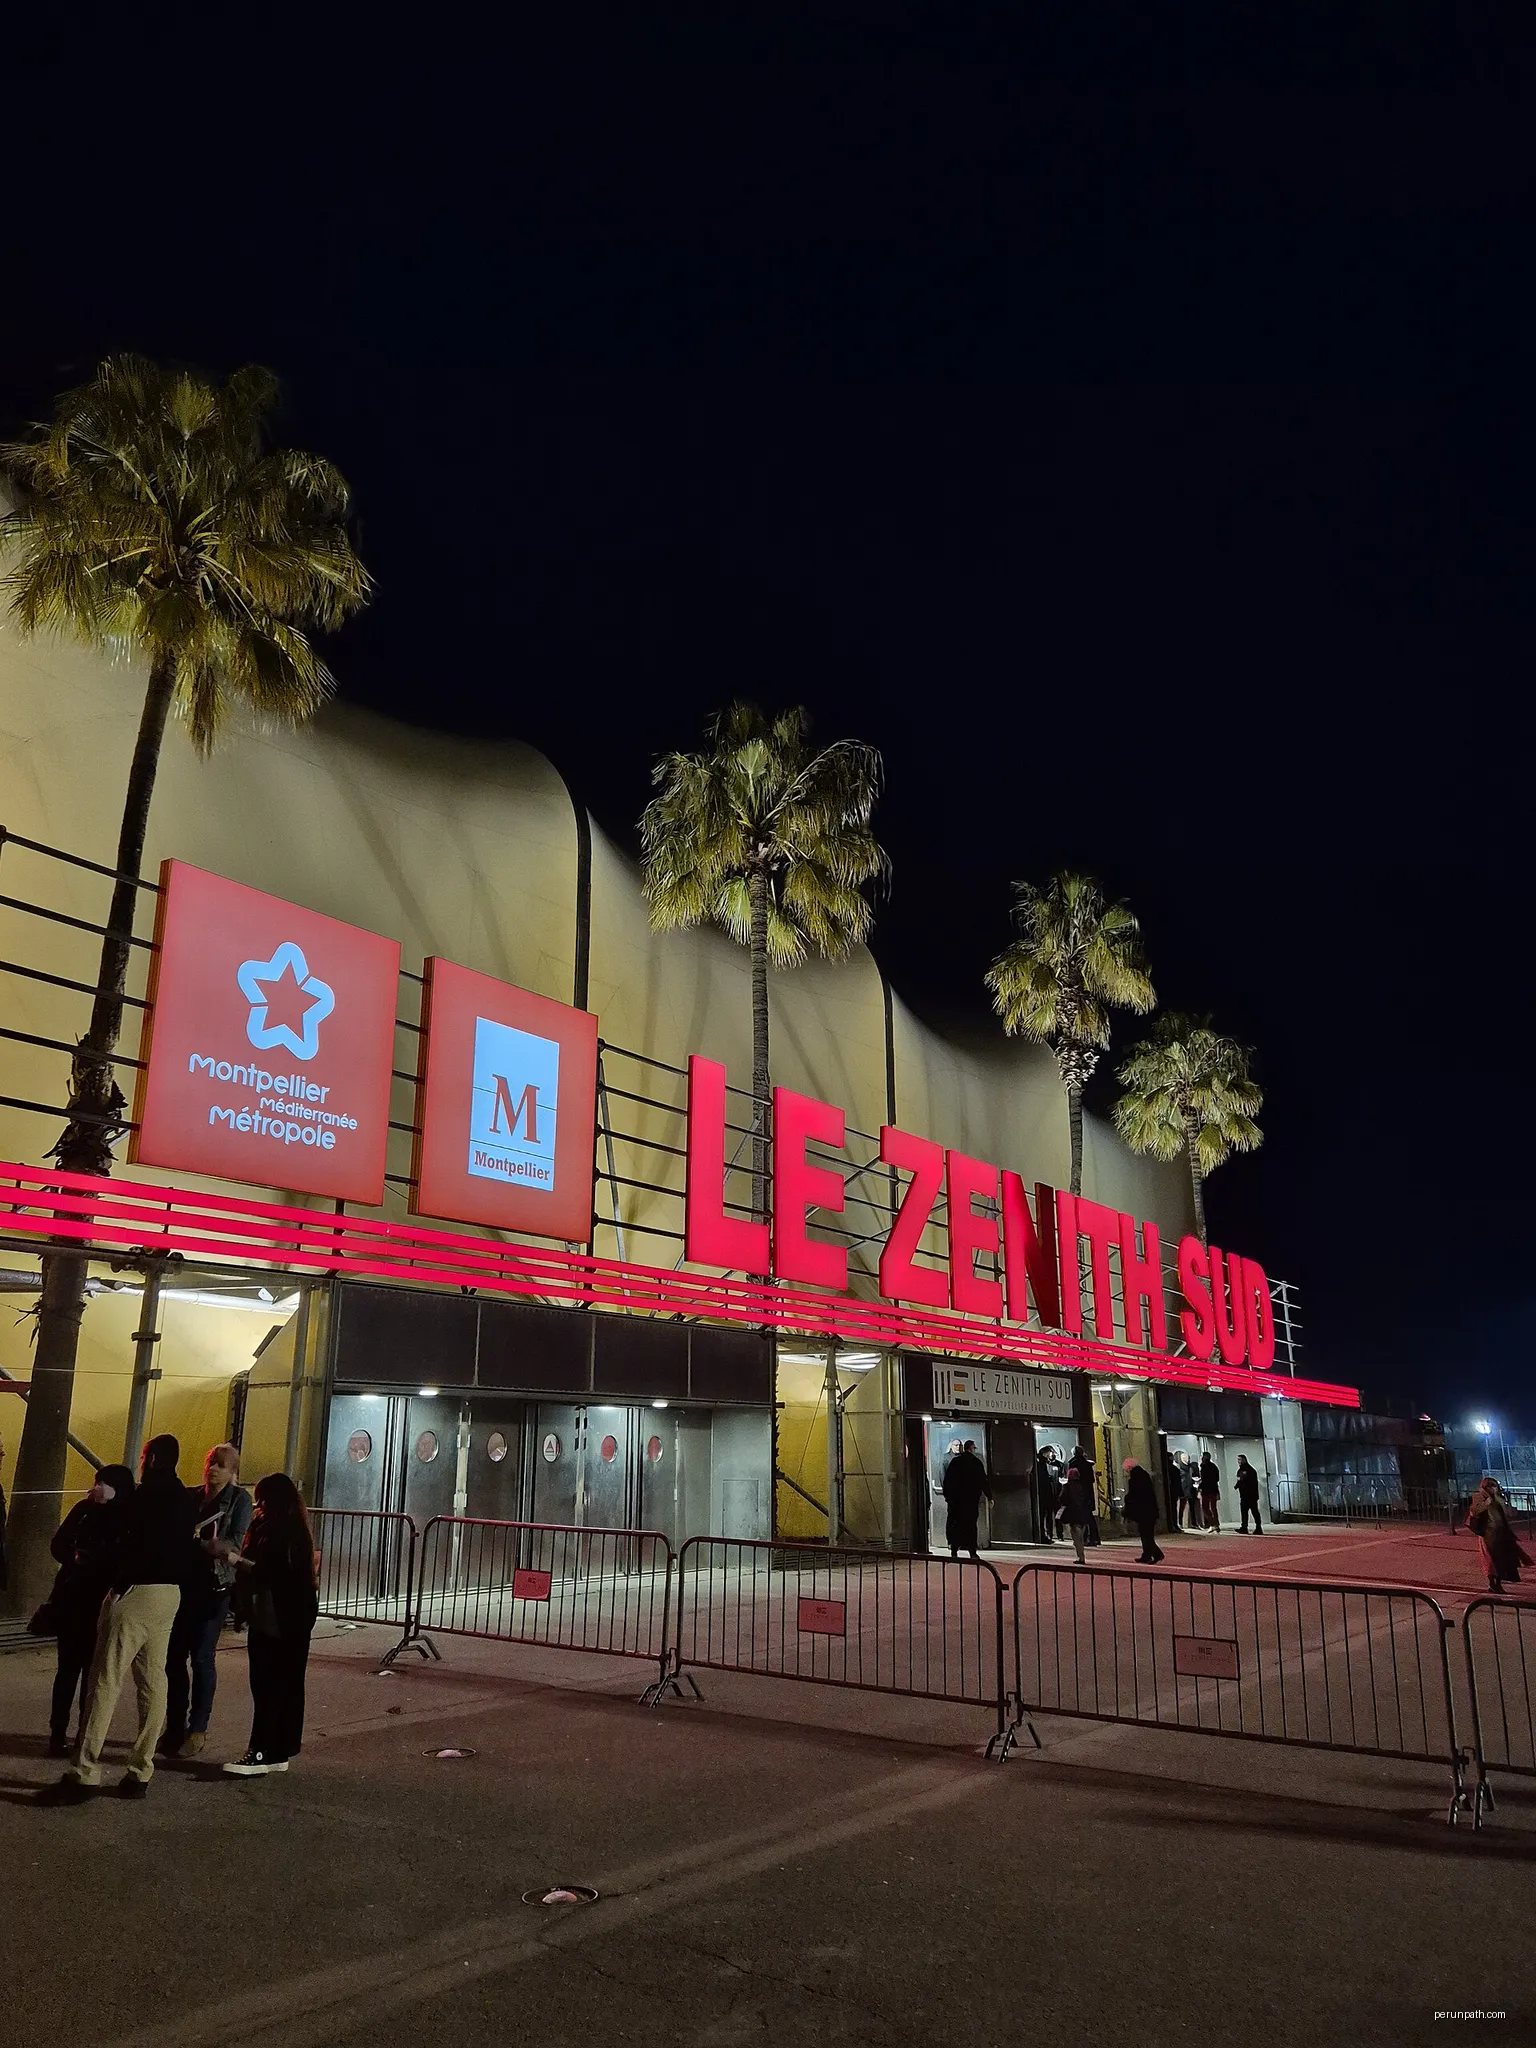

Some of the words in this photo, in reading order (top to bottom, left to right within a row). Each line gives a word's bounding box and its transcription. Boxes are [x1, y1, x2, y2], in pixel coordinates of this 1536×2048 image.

[188, 1053, 330, 1104] Montpellier
[208, 1105, 336, 1150] Métropole
[488, 1073, 541, 1145] M
[474, 1150, 550, 1181] Montpellier
[685, 1054, 848, 1291] LE
[879, 1125, 1168, 1351] ZENITH
[1176, 1235, 1275, 1370] SUD
[972, 1371, 987, 1392] LE
[994, 1373, 1042, 1397] ZENITH
[1048, 1380, 1071, 1400] SUD
